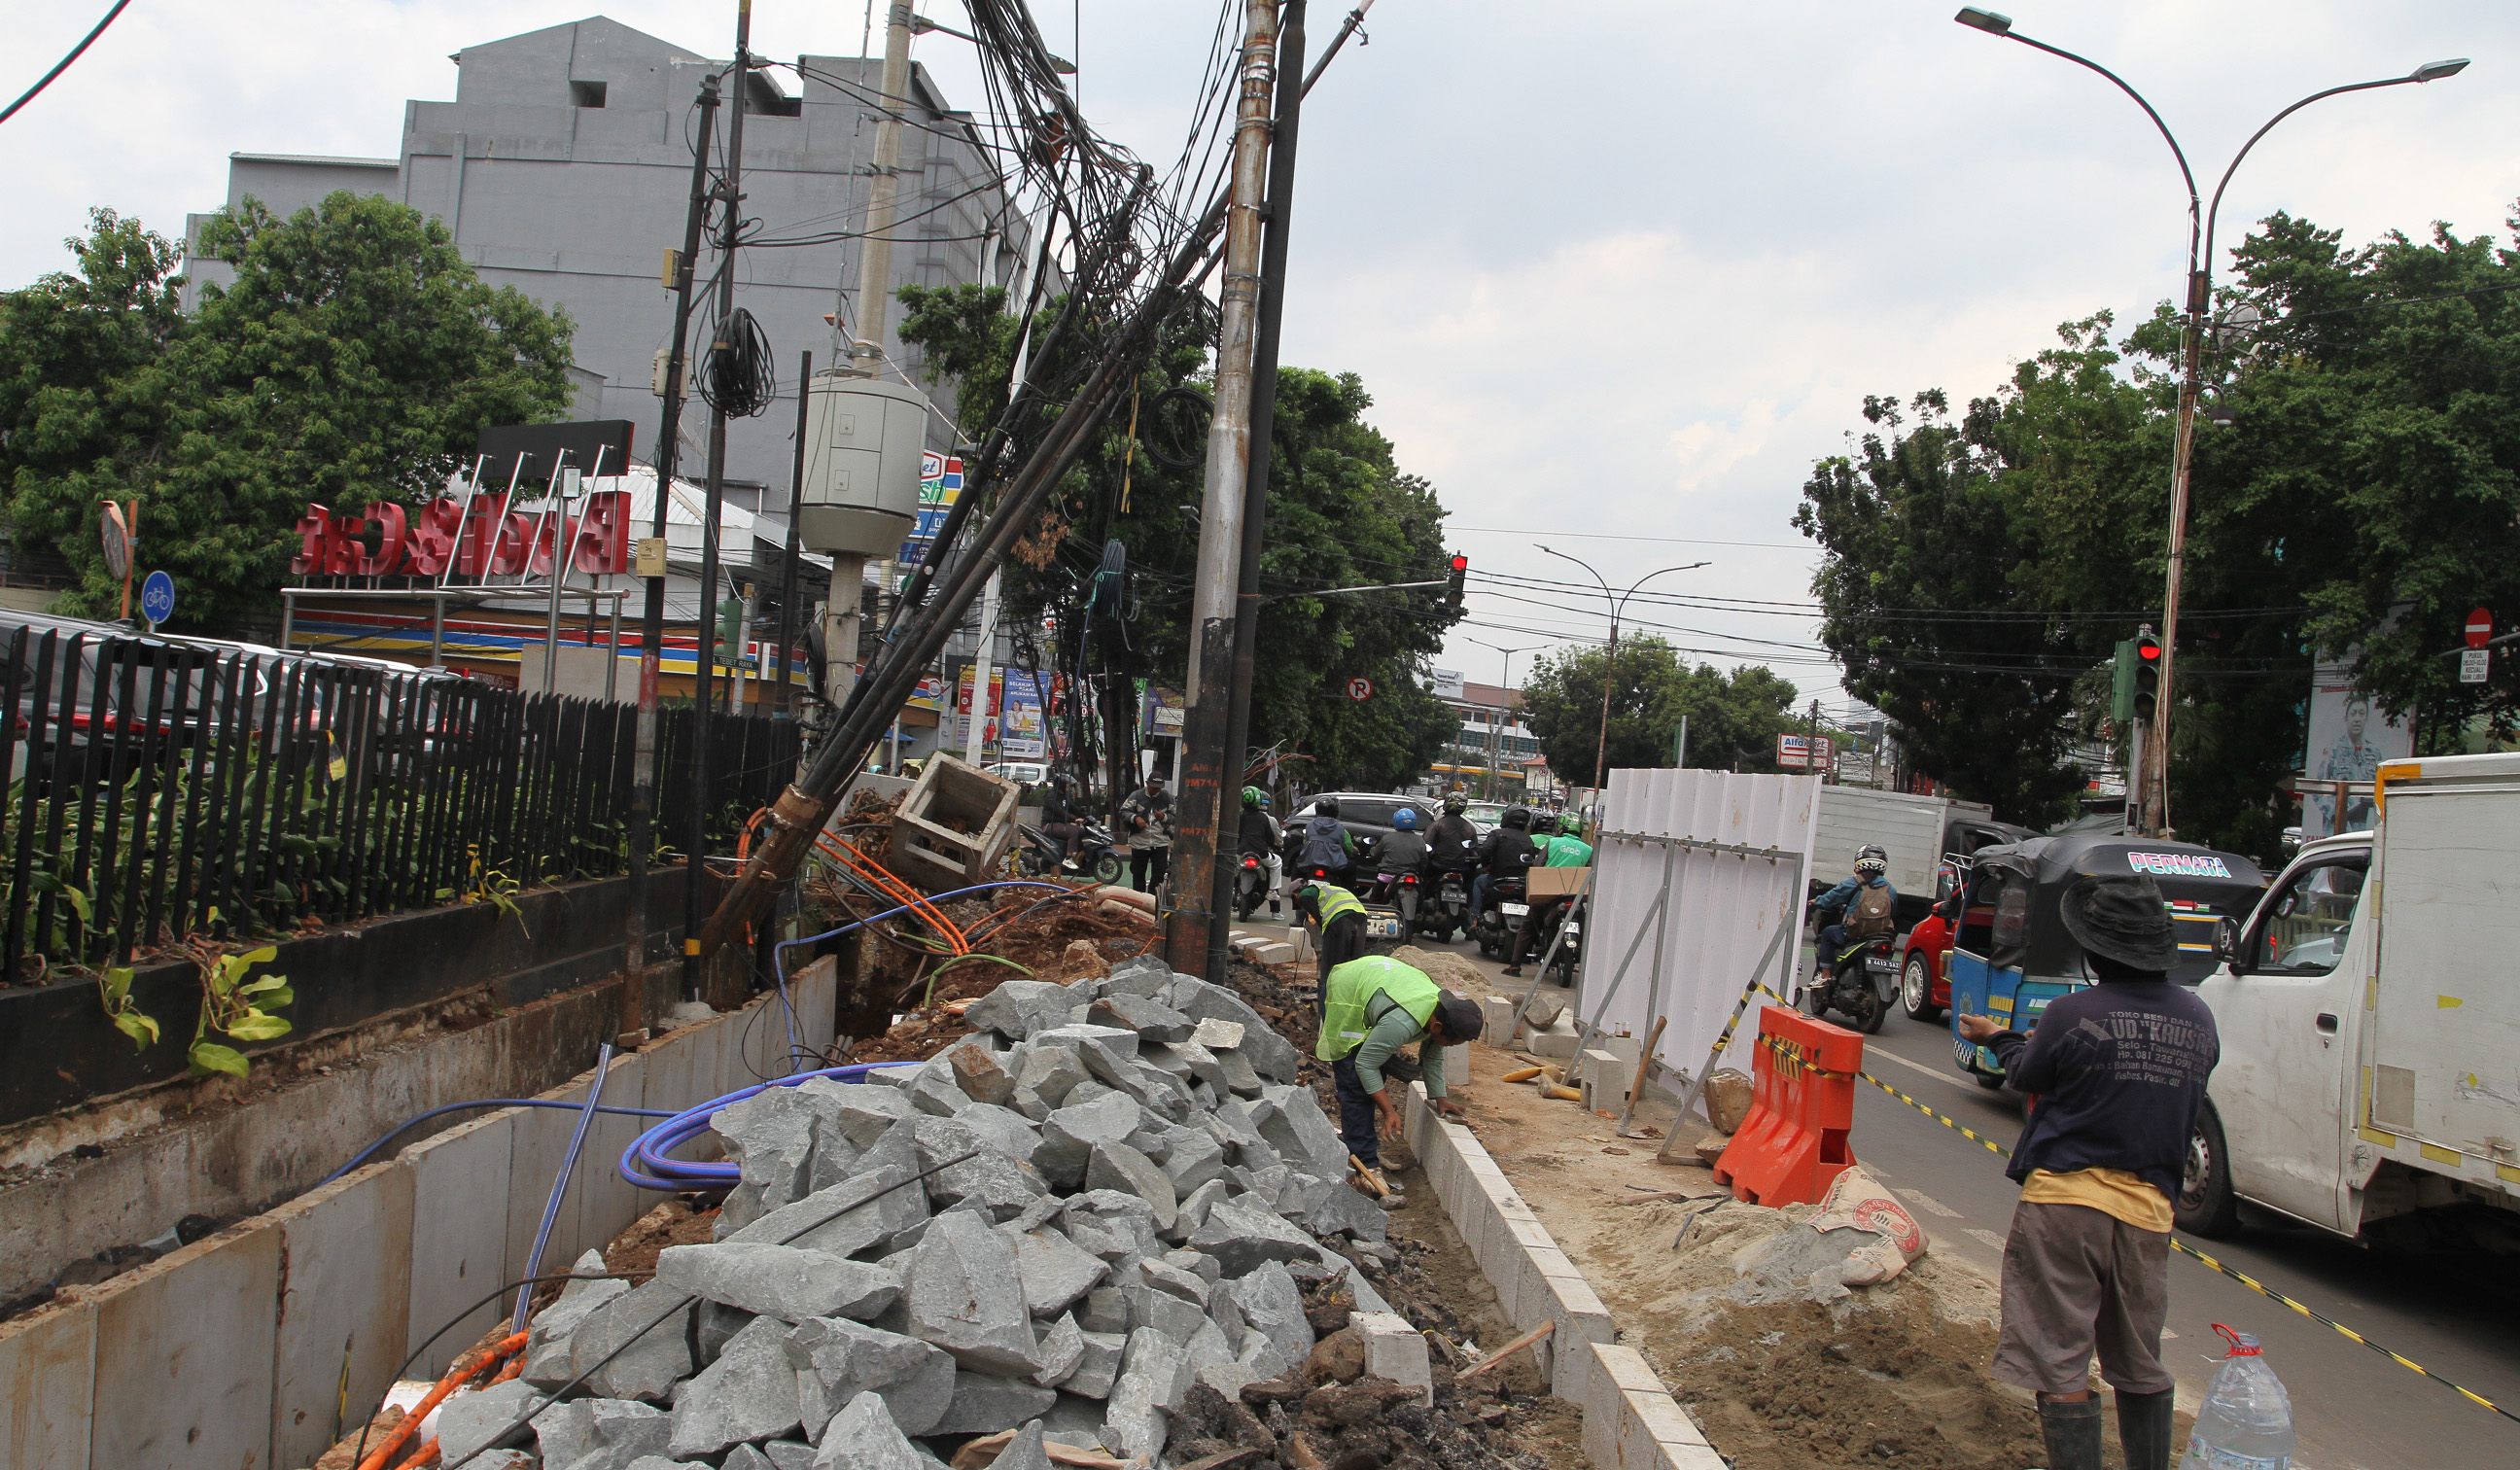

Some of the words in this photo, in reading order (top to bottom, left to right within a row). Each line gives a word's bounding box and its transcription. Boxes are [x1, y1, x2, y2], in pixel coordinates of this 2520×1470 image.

[719, 656, 737, 666] TEBET
[738, 660, 753, 669] RAYA
[1559, 845, 1582, 857] Grab
[2127, 852, 2232, 878] PERMATA
[2111, 1019, 2143, 1039] UD.
[2170, 1017, 2192, 1028] DAN
[2118, 1041, 2140, 1050] Selo
[2136, 1051, 2152, 1061] 081
[2154, 1055, 2173, 1065] 225
[2114, 1061, 2140, 1070] Bahan
[1859, 1200, 1891, 1214] SEMEN
